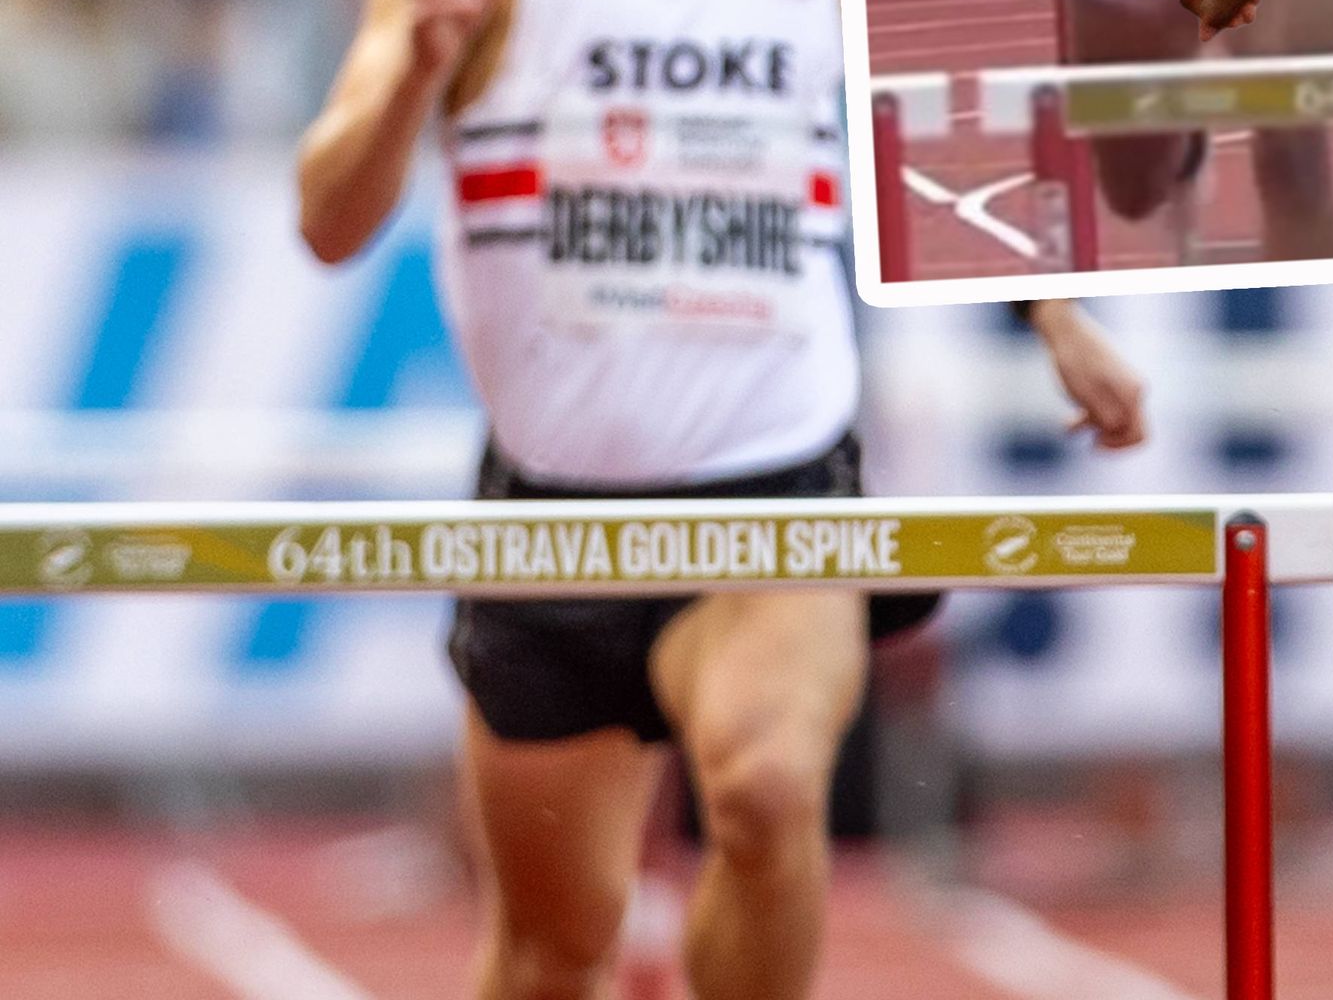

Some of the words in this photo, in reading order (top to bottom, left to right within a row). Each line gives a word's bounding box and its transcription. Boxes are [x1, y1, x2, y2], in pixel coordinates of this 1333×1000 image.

[587, 38, 791, 94] STOKE
[547, 185, 803, 275] DERBYSHIRE
[267, 523, 412, 582] 64th
[420, 522, 612, 580] OSTRAVA
[619, 520, 777, 578] GOLDEN
[785, 518, 900, 576] SPIKE
